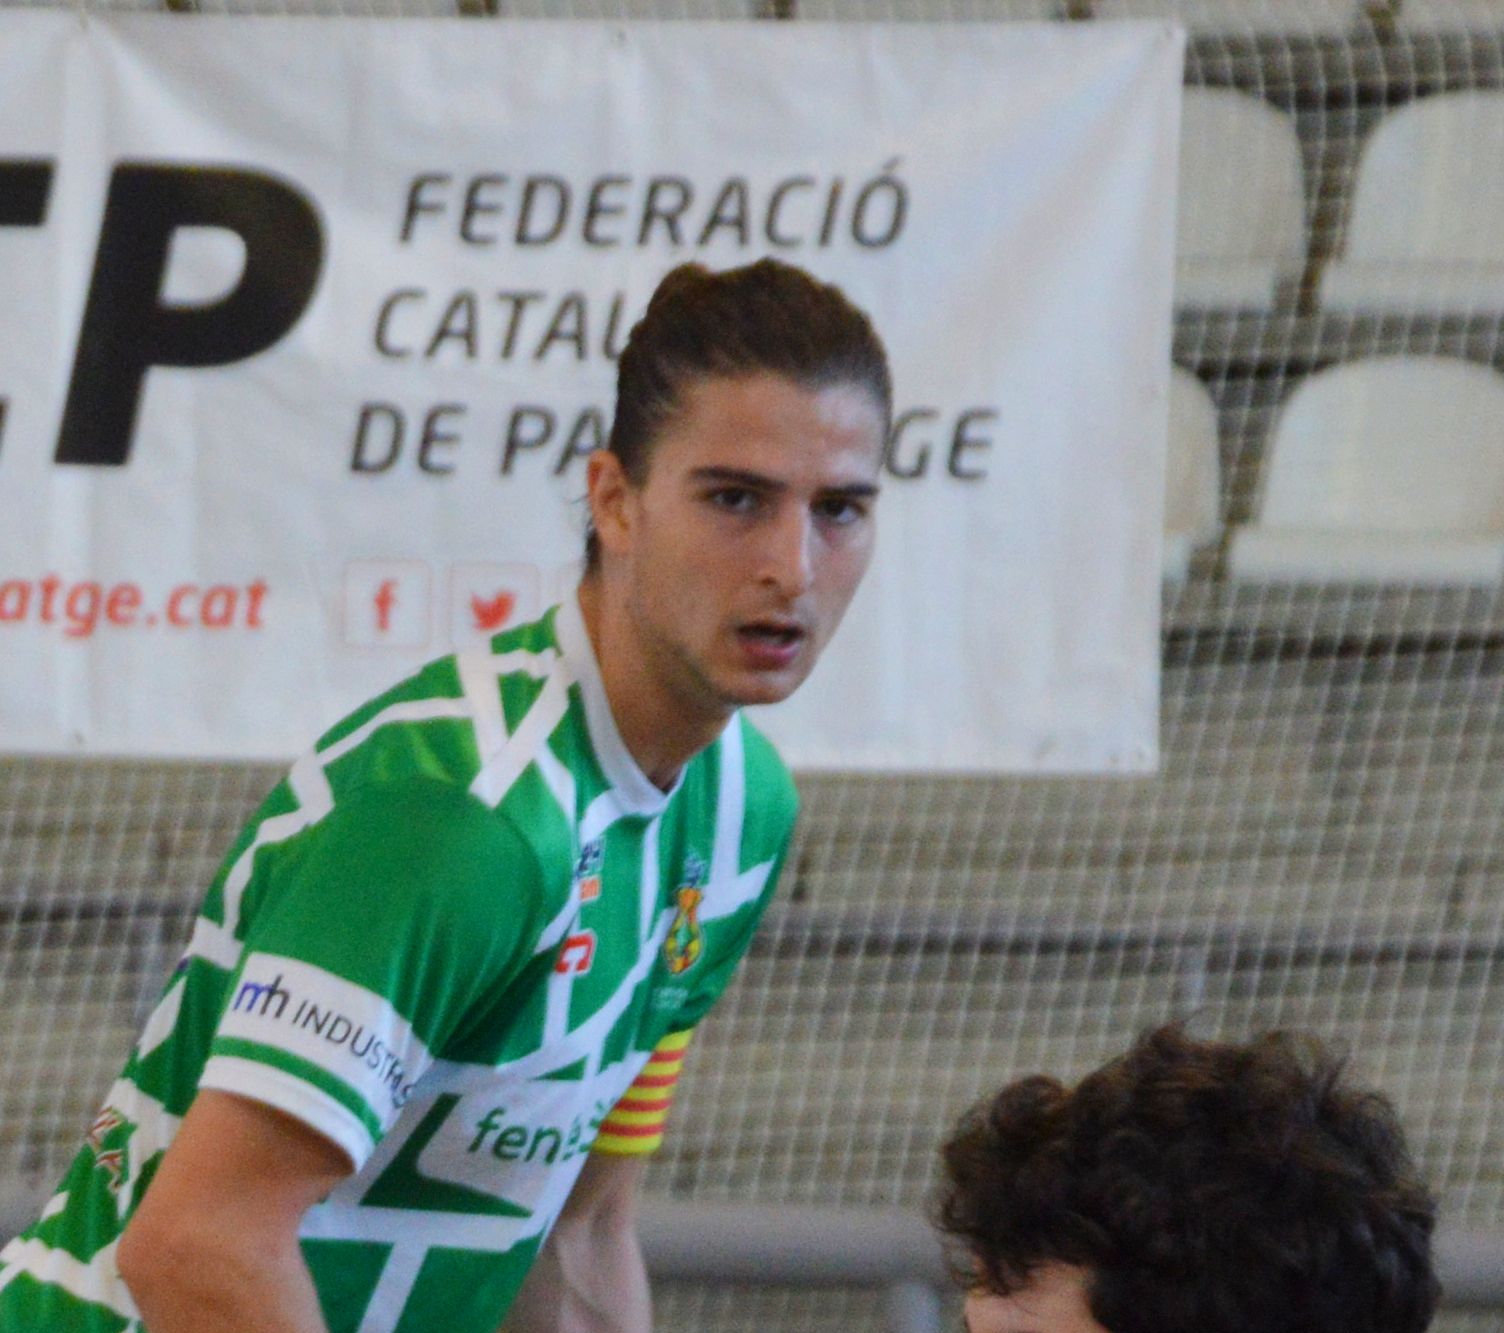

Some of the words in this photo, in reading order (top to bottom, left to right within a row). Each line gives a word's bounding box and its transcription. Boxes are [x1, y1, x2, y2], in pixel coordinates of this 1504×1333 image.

[400, 158, 913, 249] FEDERACIÓ
[373, 288, 630, 362] CATAL
[348, 401, 467, 476] DE
